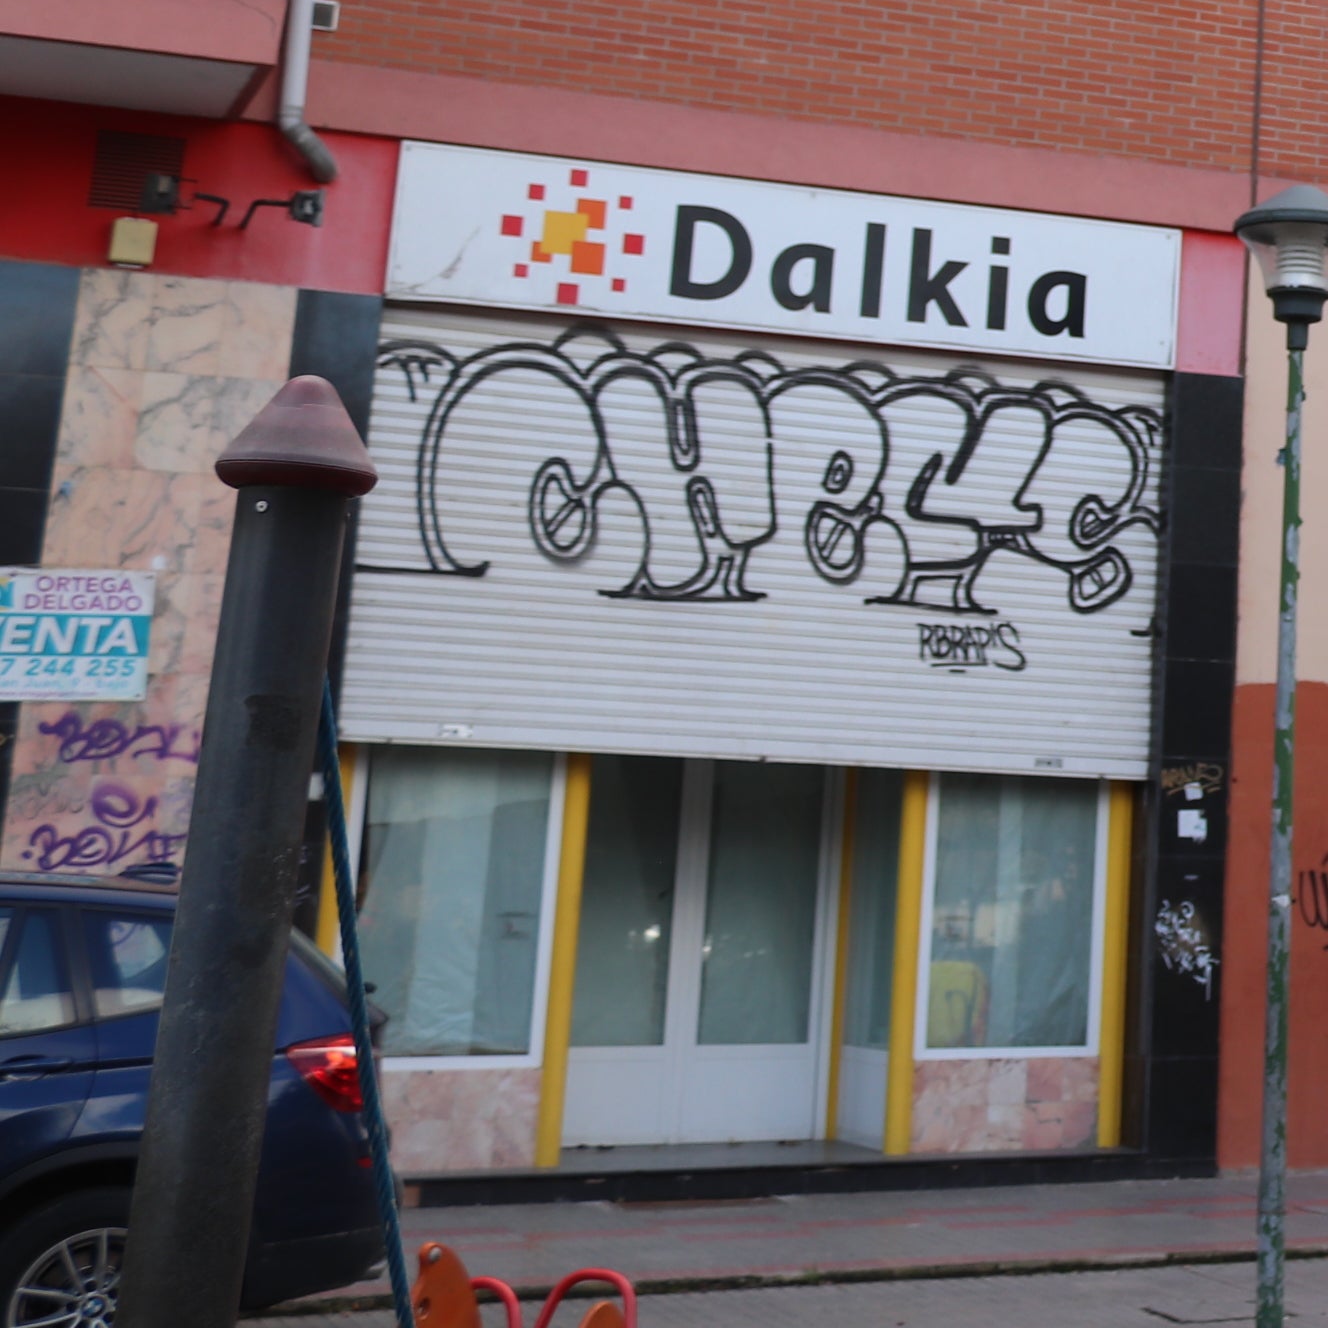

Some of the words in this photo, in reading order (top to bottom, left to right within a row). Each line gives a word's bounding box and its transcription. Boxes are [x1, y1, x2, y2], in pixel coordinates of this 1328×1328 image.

[668, 202, 1089, 339] Dalkia
[35, 575, 134, 593] ORTEGA
[23, 593, 143, 611] DELGADO
[0, 616, 139, 654] ENTA
[25, 658, 75, 676] 244
[86, 658, 136, 677] 255
